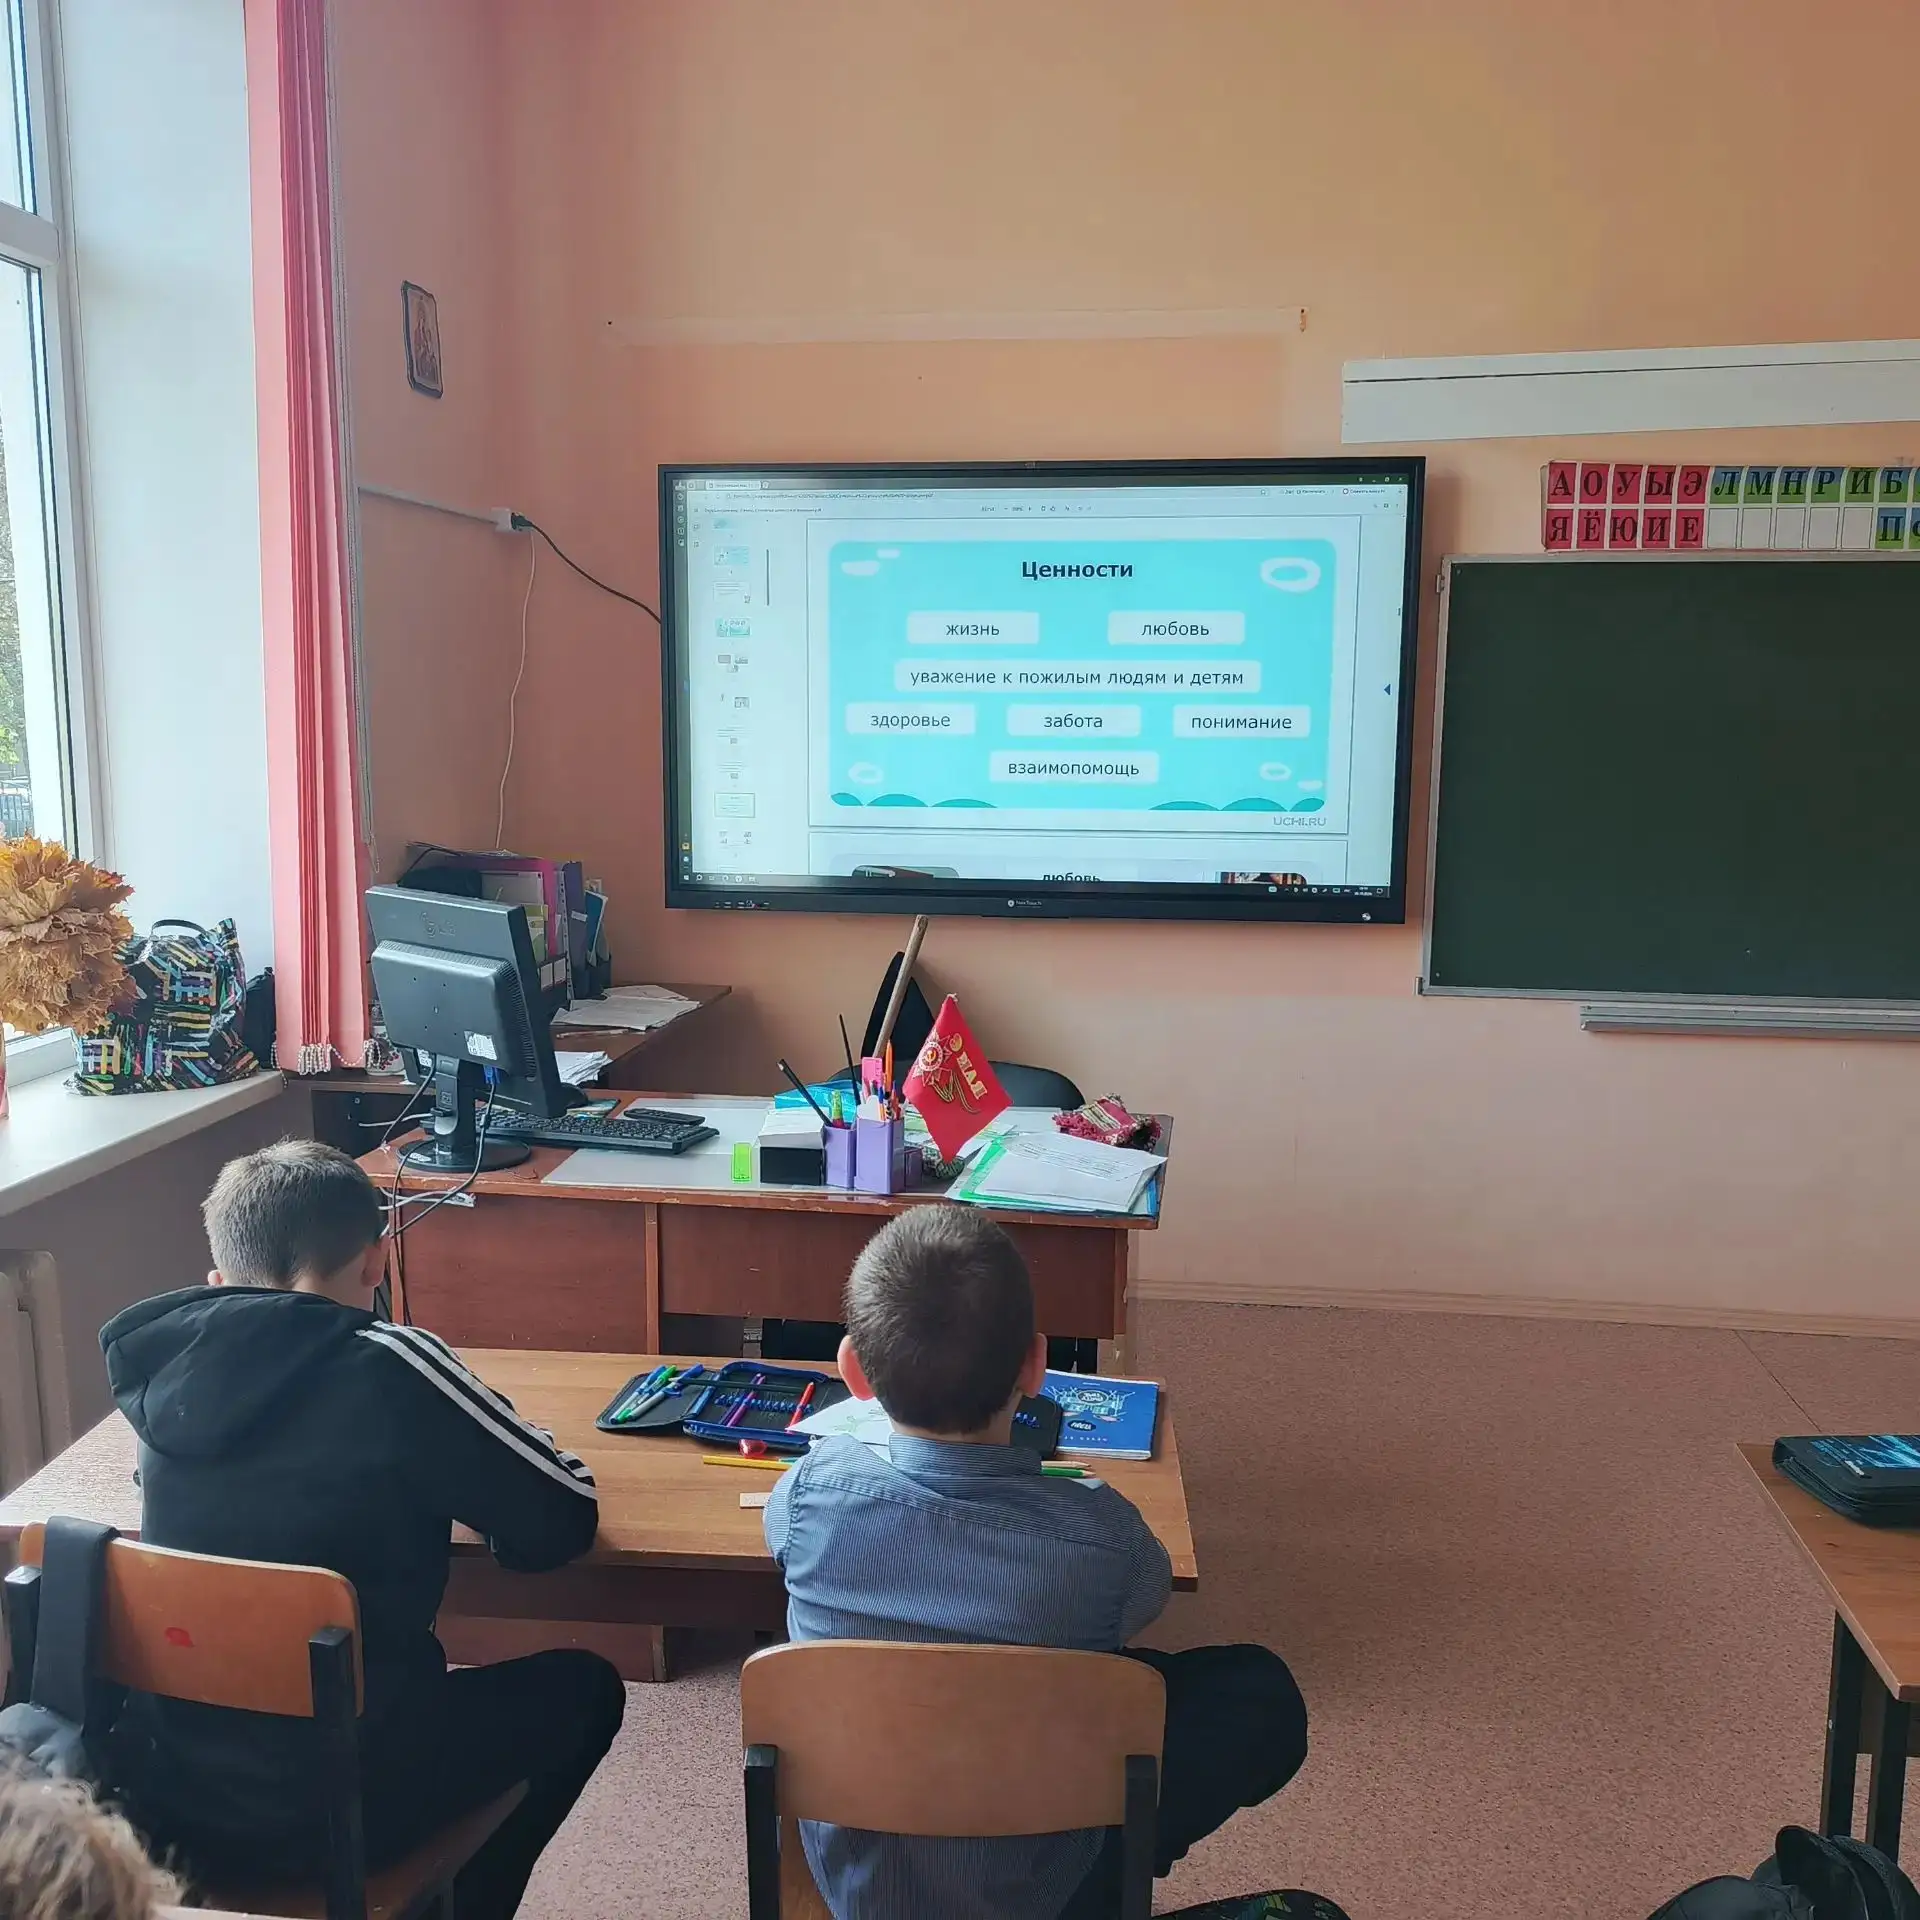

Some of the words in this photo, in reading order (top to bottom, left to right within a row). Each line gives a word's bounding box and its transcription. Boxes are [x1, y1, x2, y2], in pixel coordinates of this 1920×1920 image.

[1551, 470, 1572, 497] А
[1583, 470, 1603, 497] О
[1616, 471, 1640, 496] У
[1645, 471, 1674, 496] Ы
[1683, 471, 1703, 497] Э
[1714, 471, 1739, 496] Л
[1750, 471, 1778, 496] М
[1781, 471, 1808, 496] Н
[1815, 470, 1835, 495] Р
[1884, 470, 1903, 494] Б
[1550, 516, 1570, 542] Я
[1583, 511, 1601, 542] Ё
[1611, 516, 1638, 542] Ю
[1646, 516, 1669, 542] И
[1680, 516, 1699, 542] Е
[1878, 515, 1905, 542] П
[1022, 561, 1133, 580] Ценности
[945, 623, 1001, 636] жизнь
[1141, 620, 1210, 636] любовь
[910, 671, 996, 687] уважение
[1003, 671, 1012, 685] к
[1019, 671, 1101, 686] пожилым
[1107, 671, 1166, 687] людям
[1173, 672, 1184, 686] и
[1189, 671, 1243, 687] детям
[870, 713, 951, 730] здоровье
[1043, 712, 1104, 728] забота
[1191, 715, 1292, 730] понимание
[1008, 762, 1140, 777] взаимопомощь
[1273, 816, 1327, 827] UCHI.RU
[1042, 872, 1101, 882] любовь
[956, 1052, 988, 1100] МАЯ
